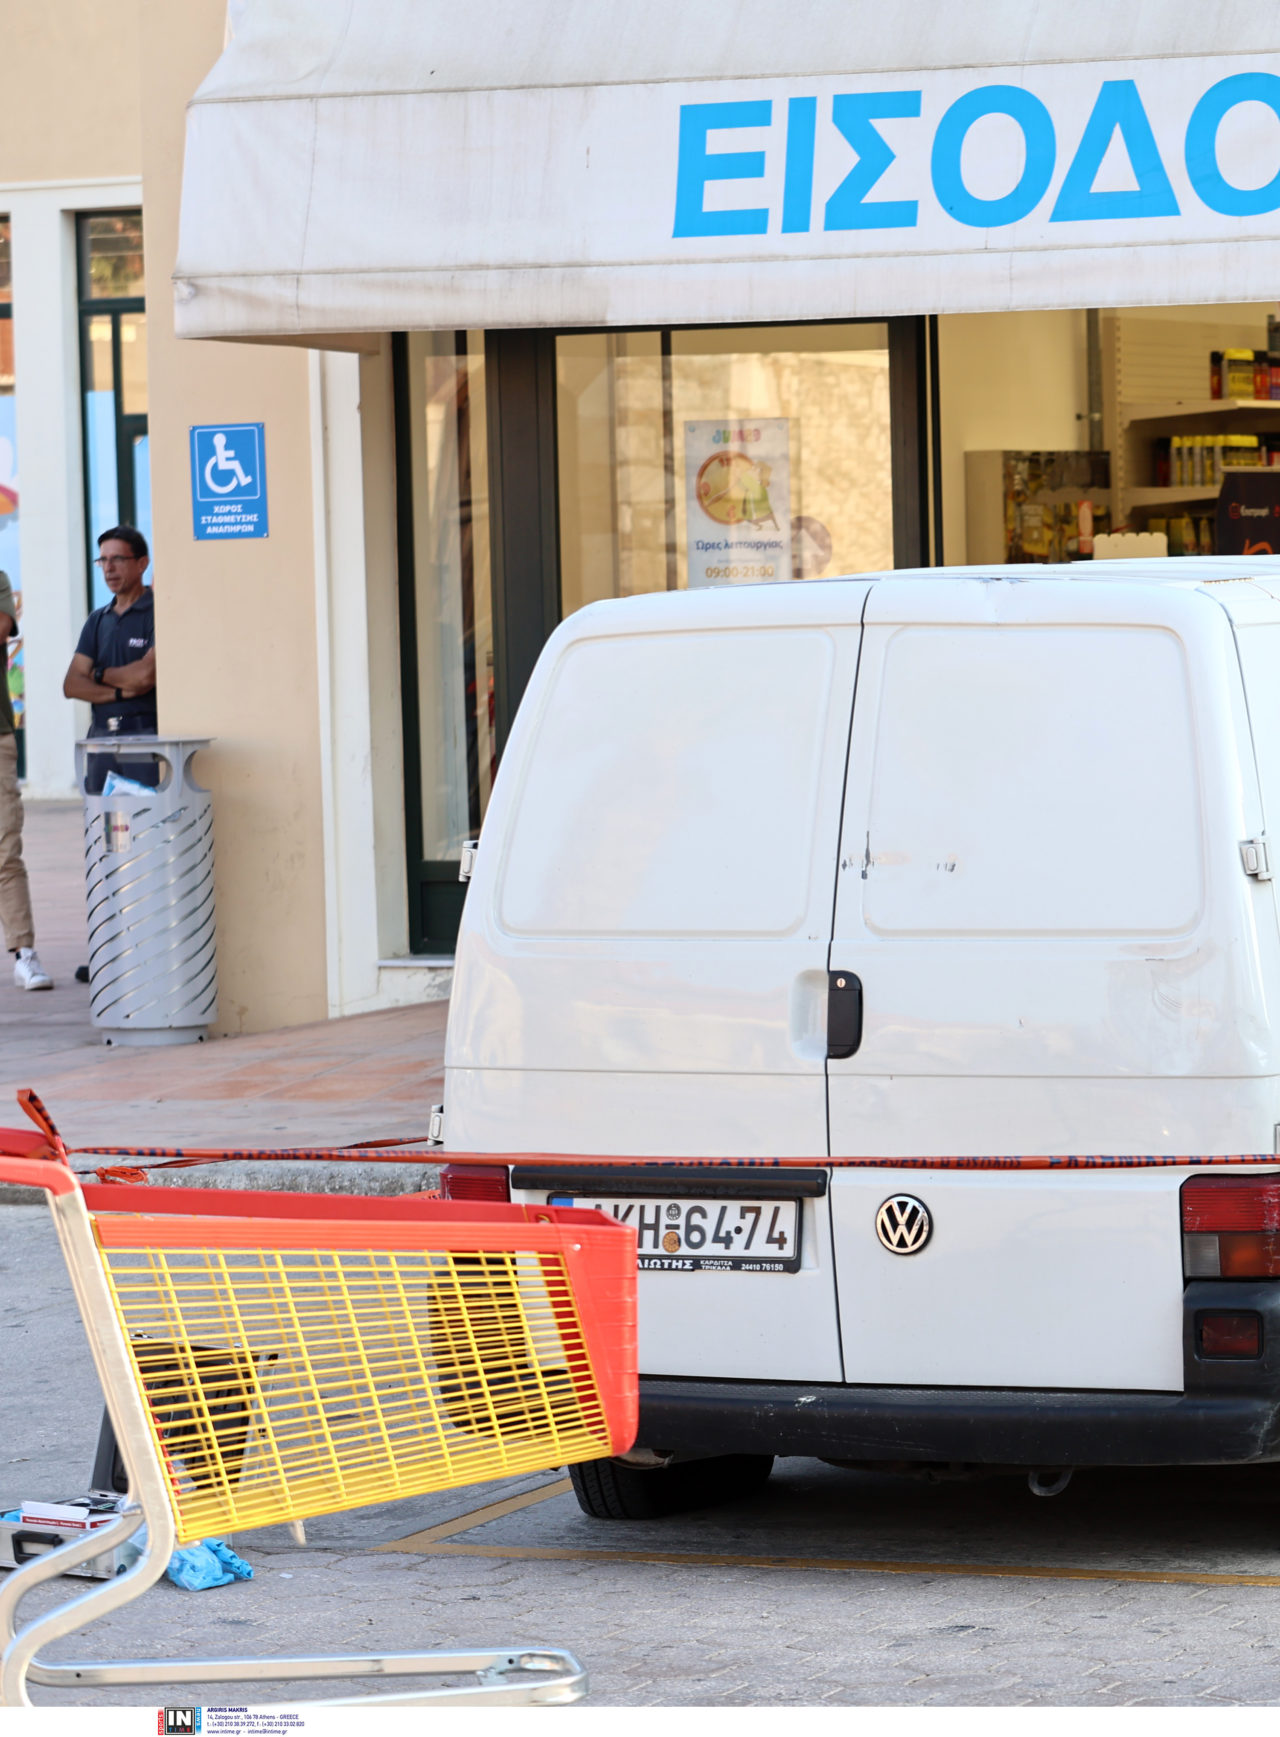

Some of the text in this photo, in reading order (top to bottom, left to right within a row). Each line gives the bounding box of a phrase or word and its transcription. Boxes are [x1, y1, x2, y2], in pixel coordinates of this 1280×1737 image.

[213, 504, 243, 513] ΧΩΡΟΣ
[206, 524, 254, 534] ΑΝΑΠΗΡΩΝ
[705, 566, 775, 578] 09:00-21:00
